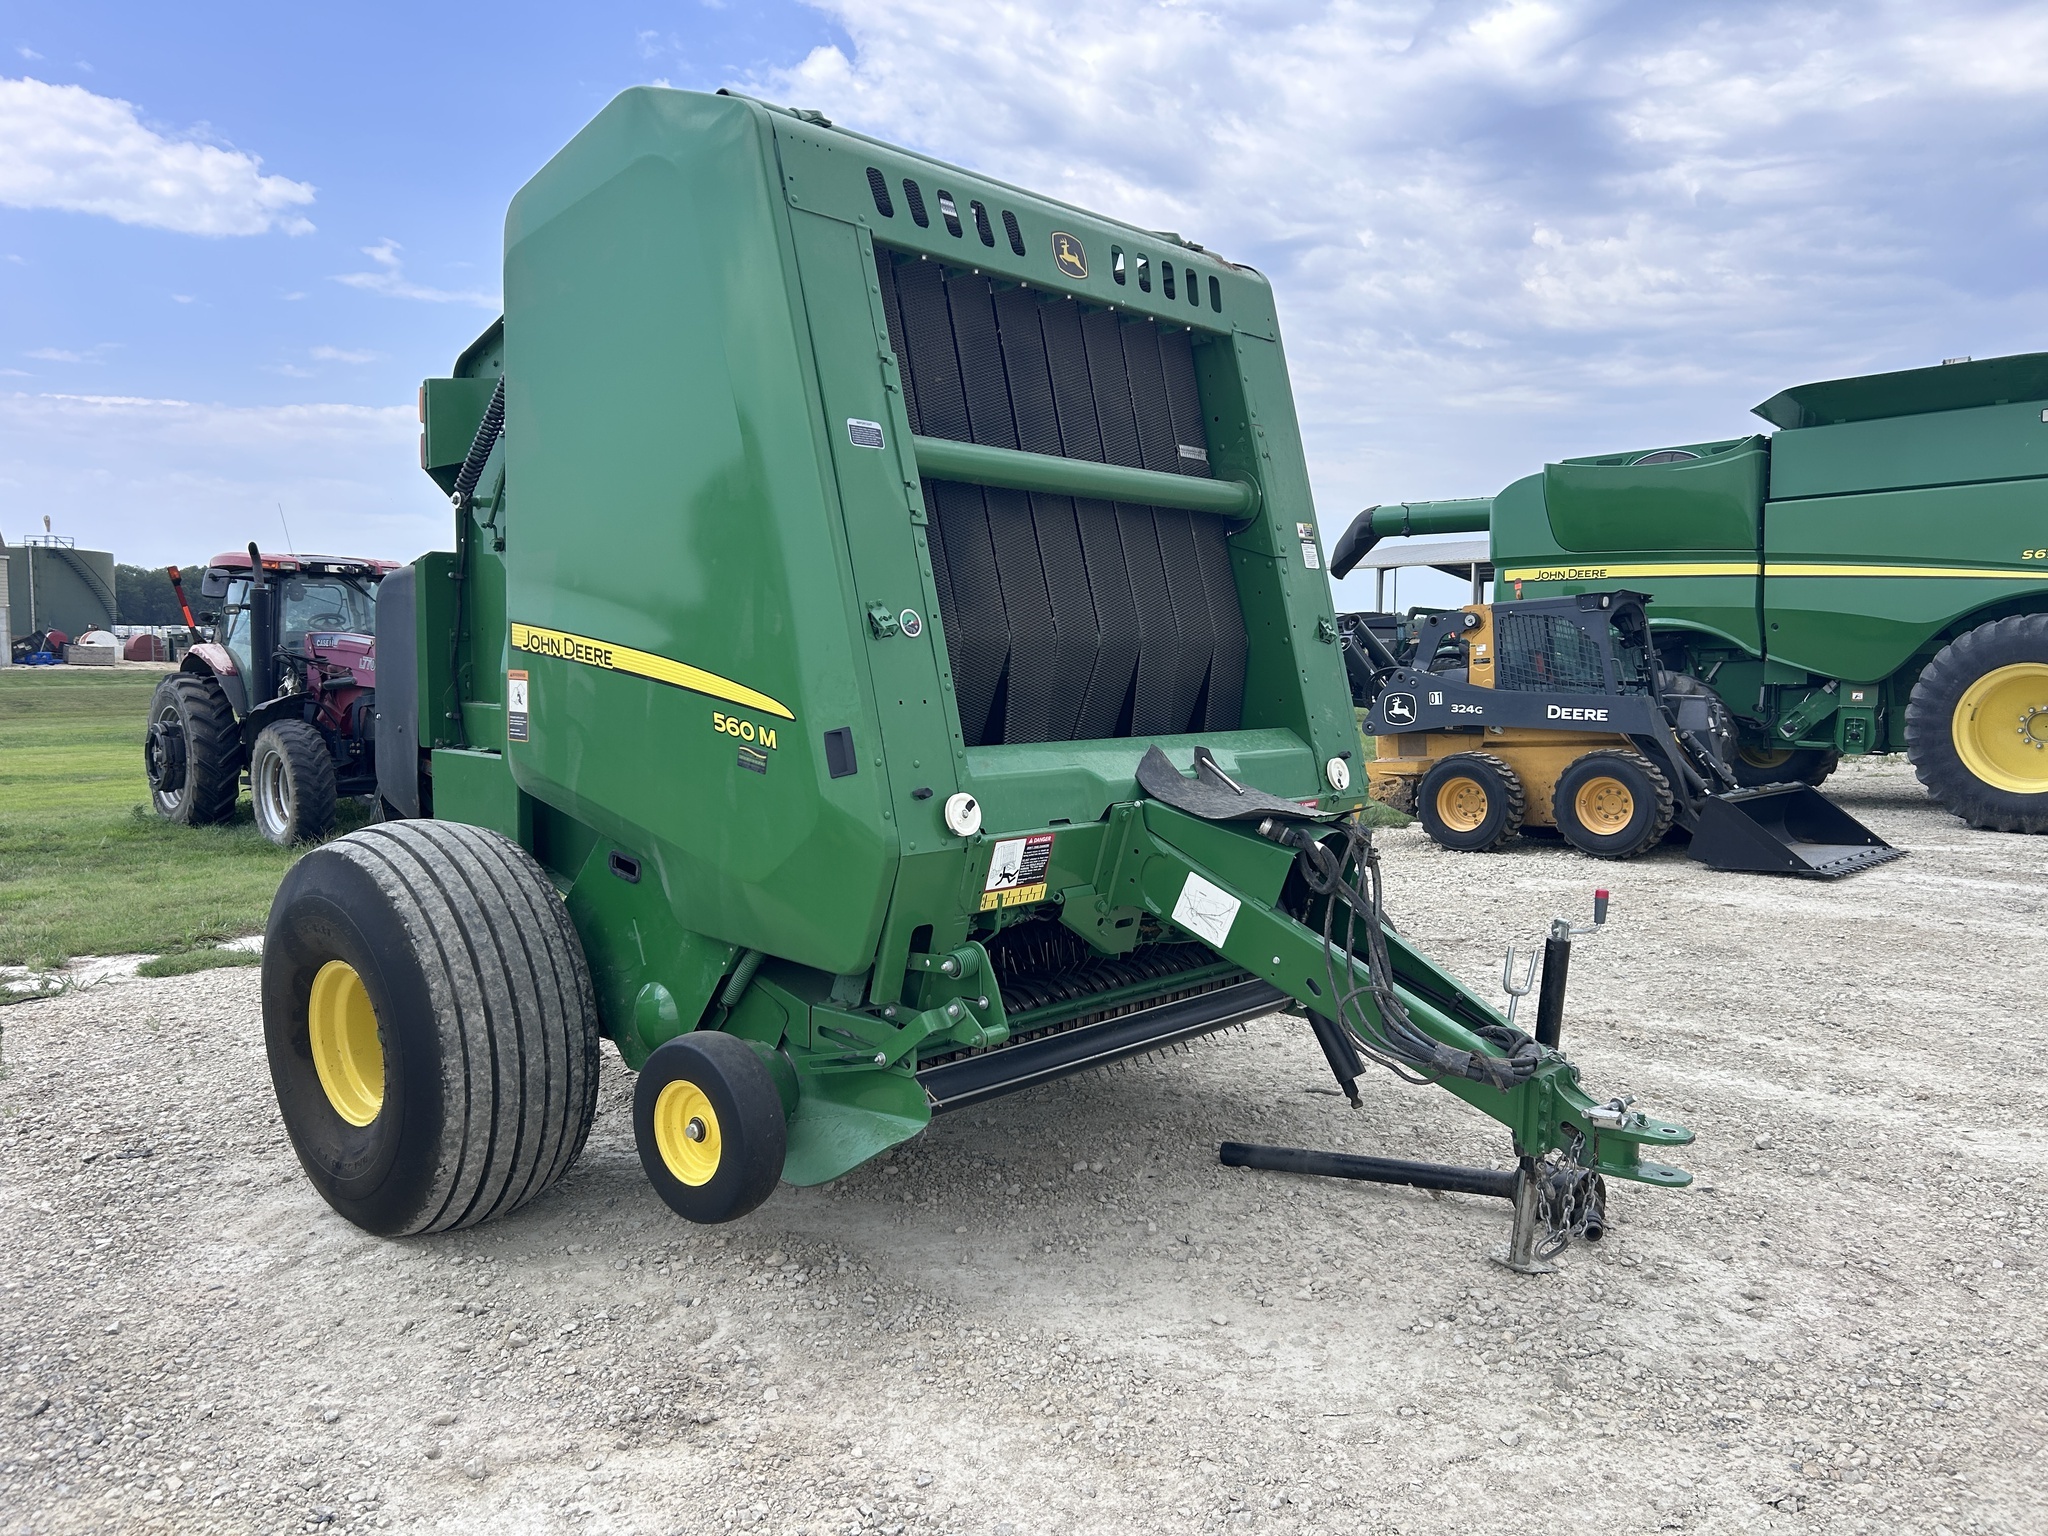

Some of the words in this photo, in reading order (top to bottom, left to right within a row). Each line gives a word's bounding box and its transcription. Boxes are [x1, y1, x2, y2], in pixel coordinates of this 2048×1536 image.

[2021, 549, 2048, 560] S6
[1535, 570, 1566, 580] JOHN
[1568, 569, 1608, 579] DEERE
[523, 630, 561, 655] JOHN
[564, 637, 613, 667] DEERE
[1429, 692, 1442, 705] 01
[1450, 704, 1483, 714] 324G
[1547, 704, 1609, 721] DEERE
[712, 710, 756, 742] 560
[758, 724, 778, 750] M
[1033, 836, 1052, 844] DANGER
